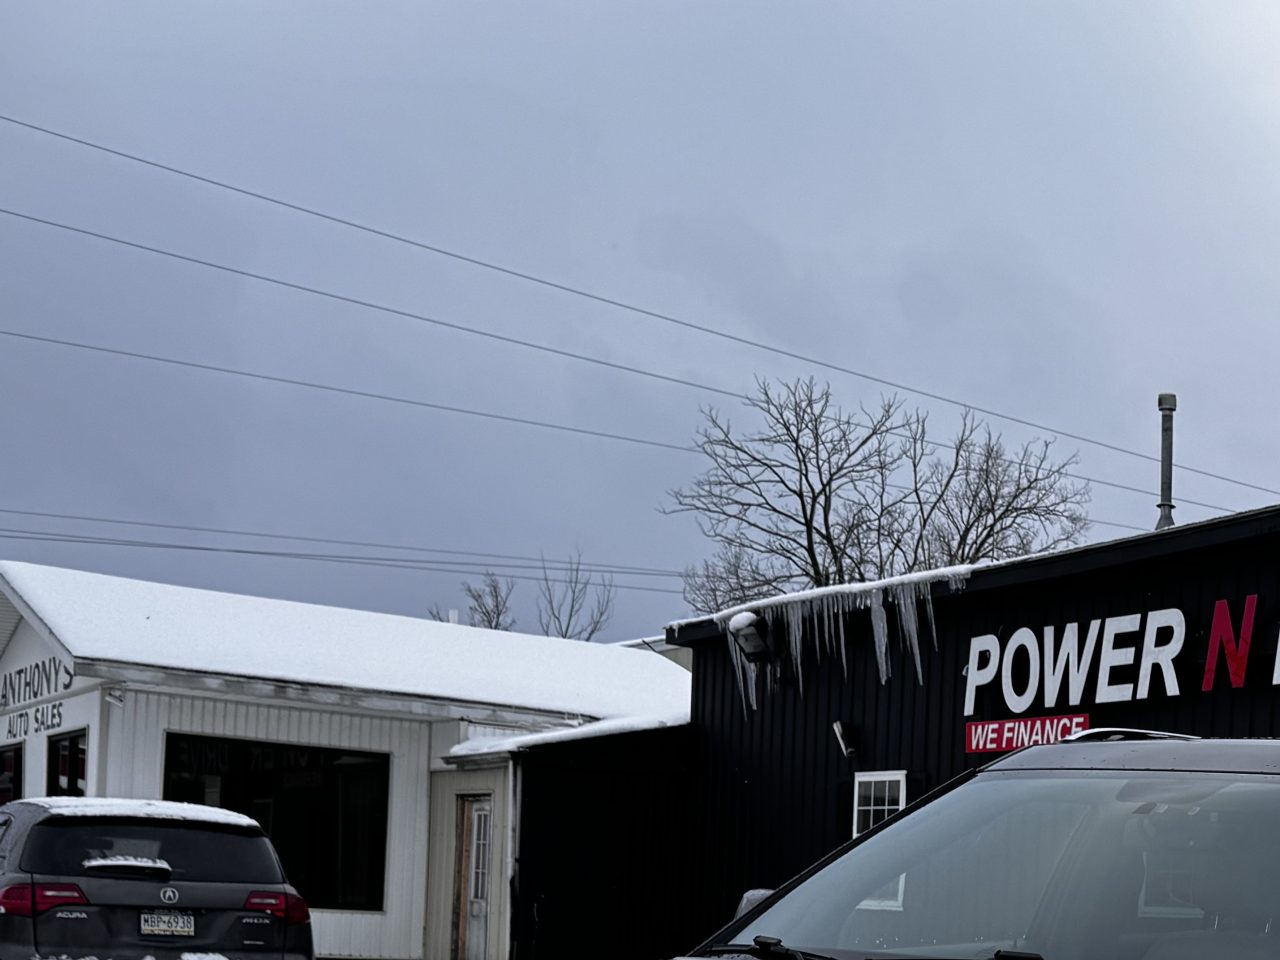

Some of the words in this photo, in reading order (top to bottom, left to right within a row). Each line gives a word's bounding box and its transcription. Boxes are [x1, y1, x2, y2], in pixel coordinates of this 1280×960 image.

[964, 608, 1186, 716] POWER
[1202, 594, 1257, 691] N
[7, 711, 29, 739] AUTO
[34, 702, 63, 733] SALES
[971, 724, 999, 750] WE
[1002, 717, 1084, 748] FINANCE
[56, 911, 88, 919] ACURA
